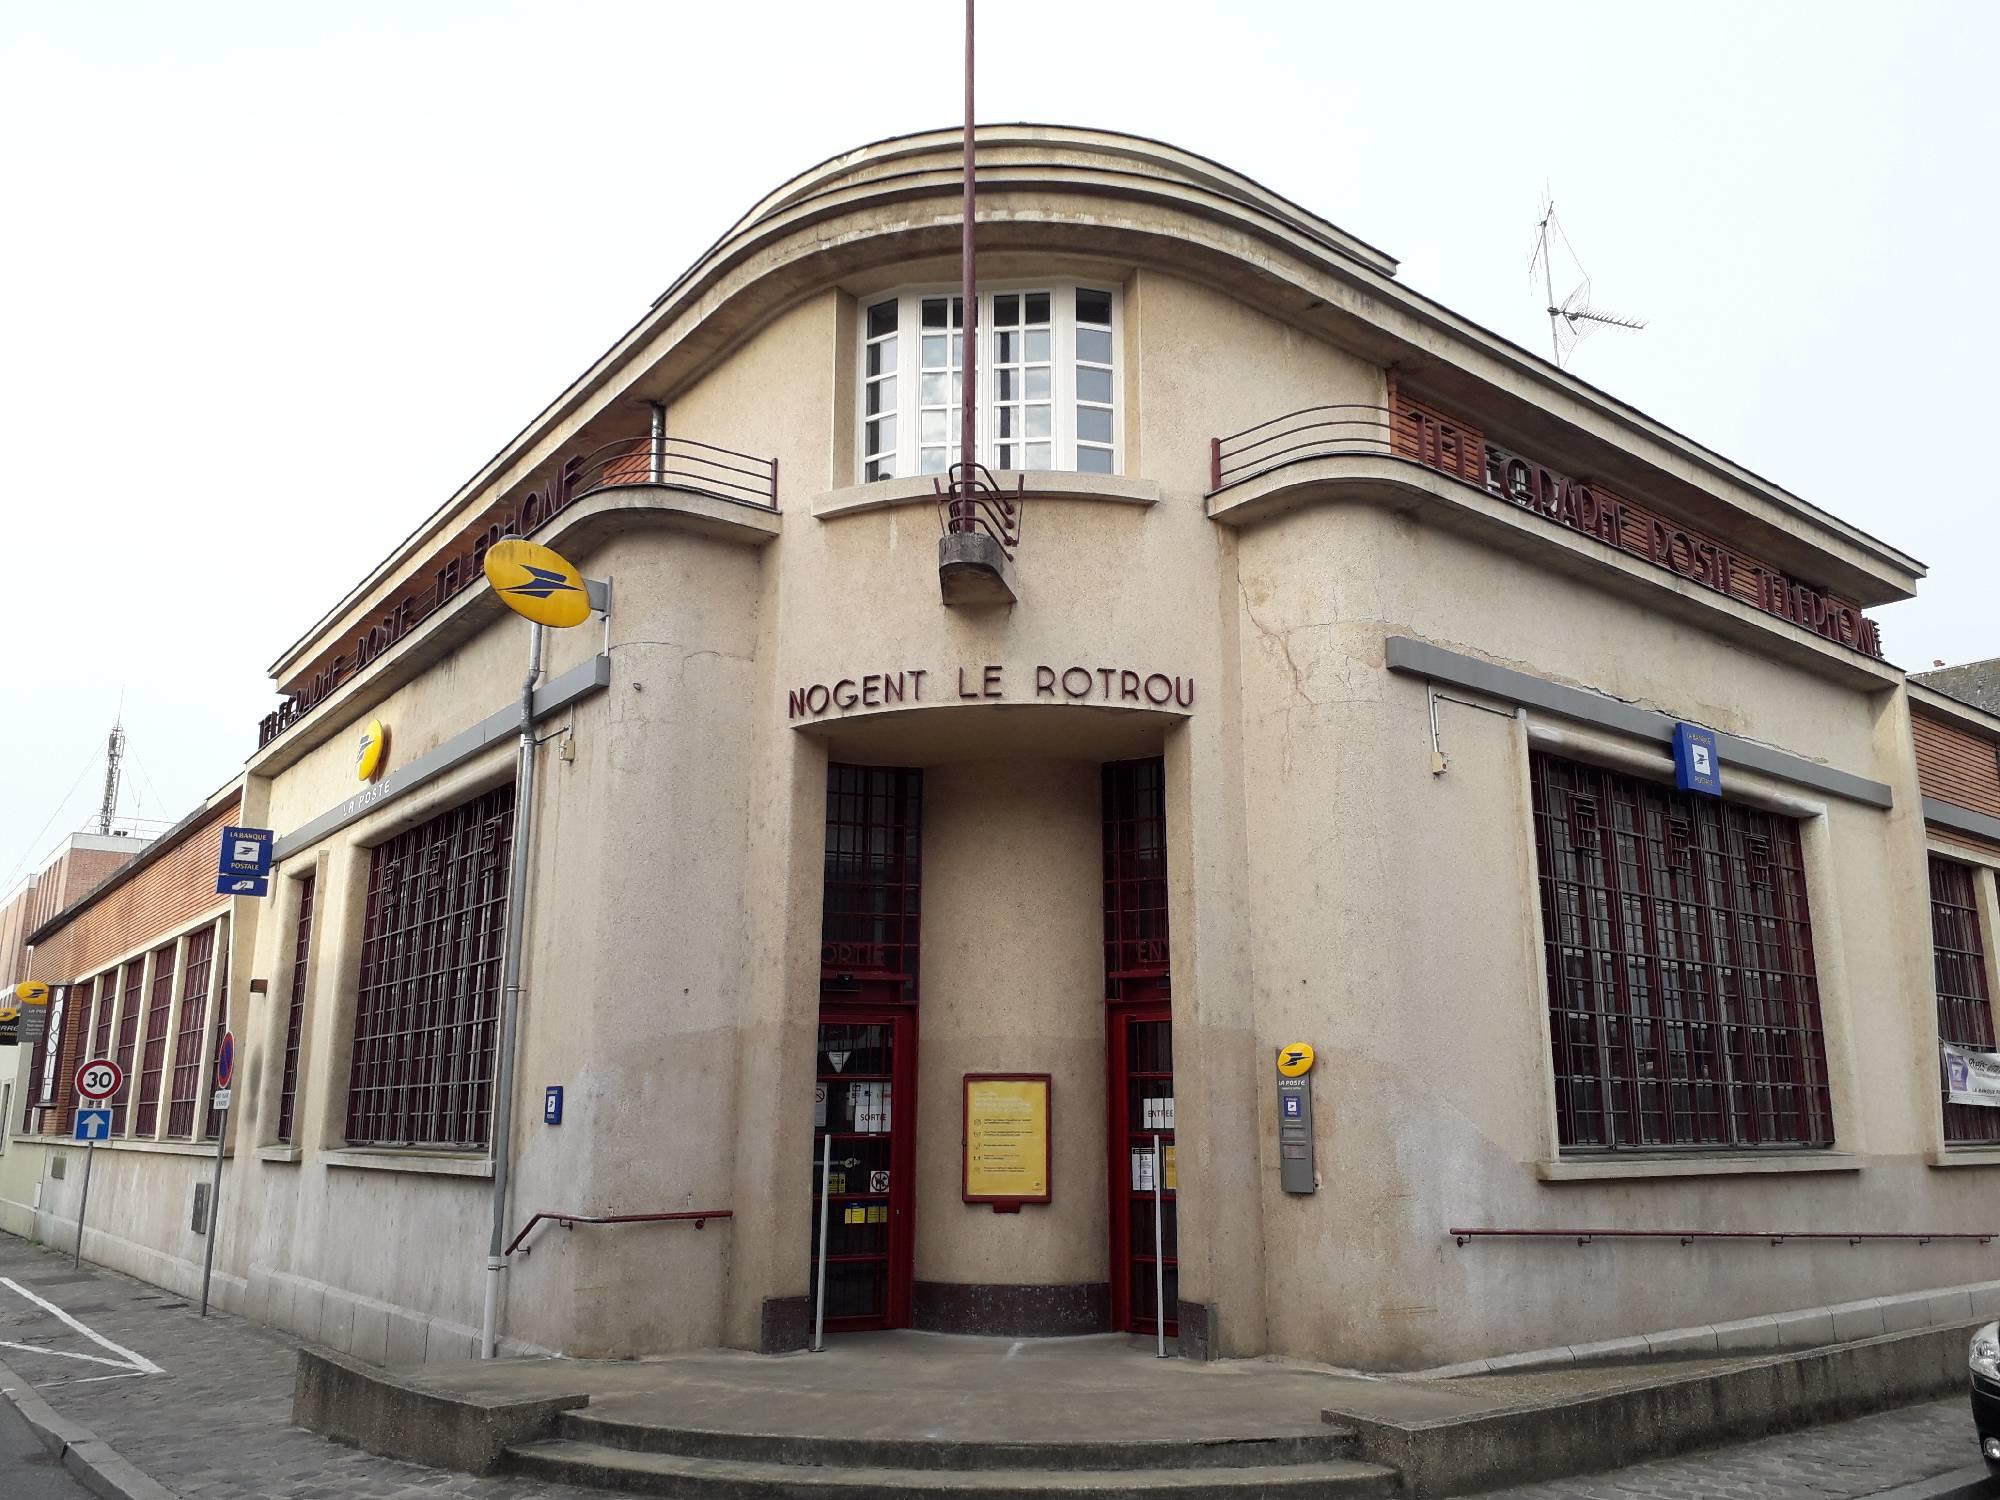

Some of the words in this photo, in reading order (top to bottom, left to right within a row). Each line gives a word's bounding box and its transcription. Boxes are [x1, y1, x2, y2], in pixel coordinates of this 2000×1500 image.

[1646, 518, 1738, 594] POSTE
[355, 596, 415, 671] POSTE
[788, 669, 927, 719] NOGENT
[959, 665, 1004, 698] LE
[1036, 665, 1194, 707] ROTROU
[343, 800, 355, 817] LA
[359, 779, 391, 809] POSTE
[238, 832, 268, 841] BANQUE
[230, 862, 260, 871] POSTALE
[86, 1071, 112, 1089] 30
